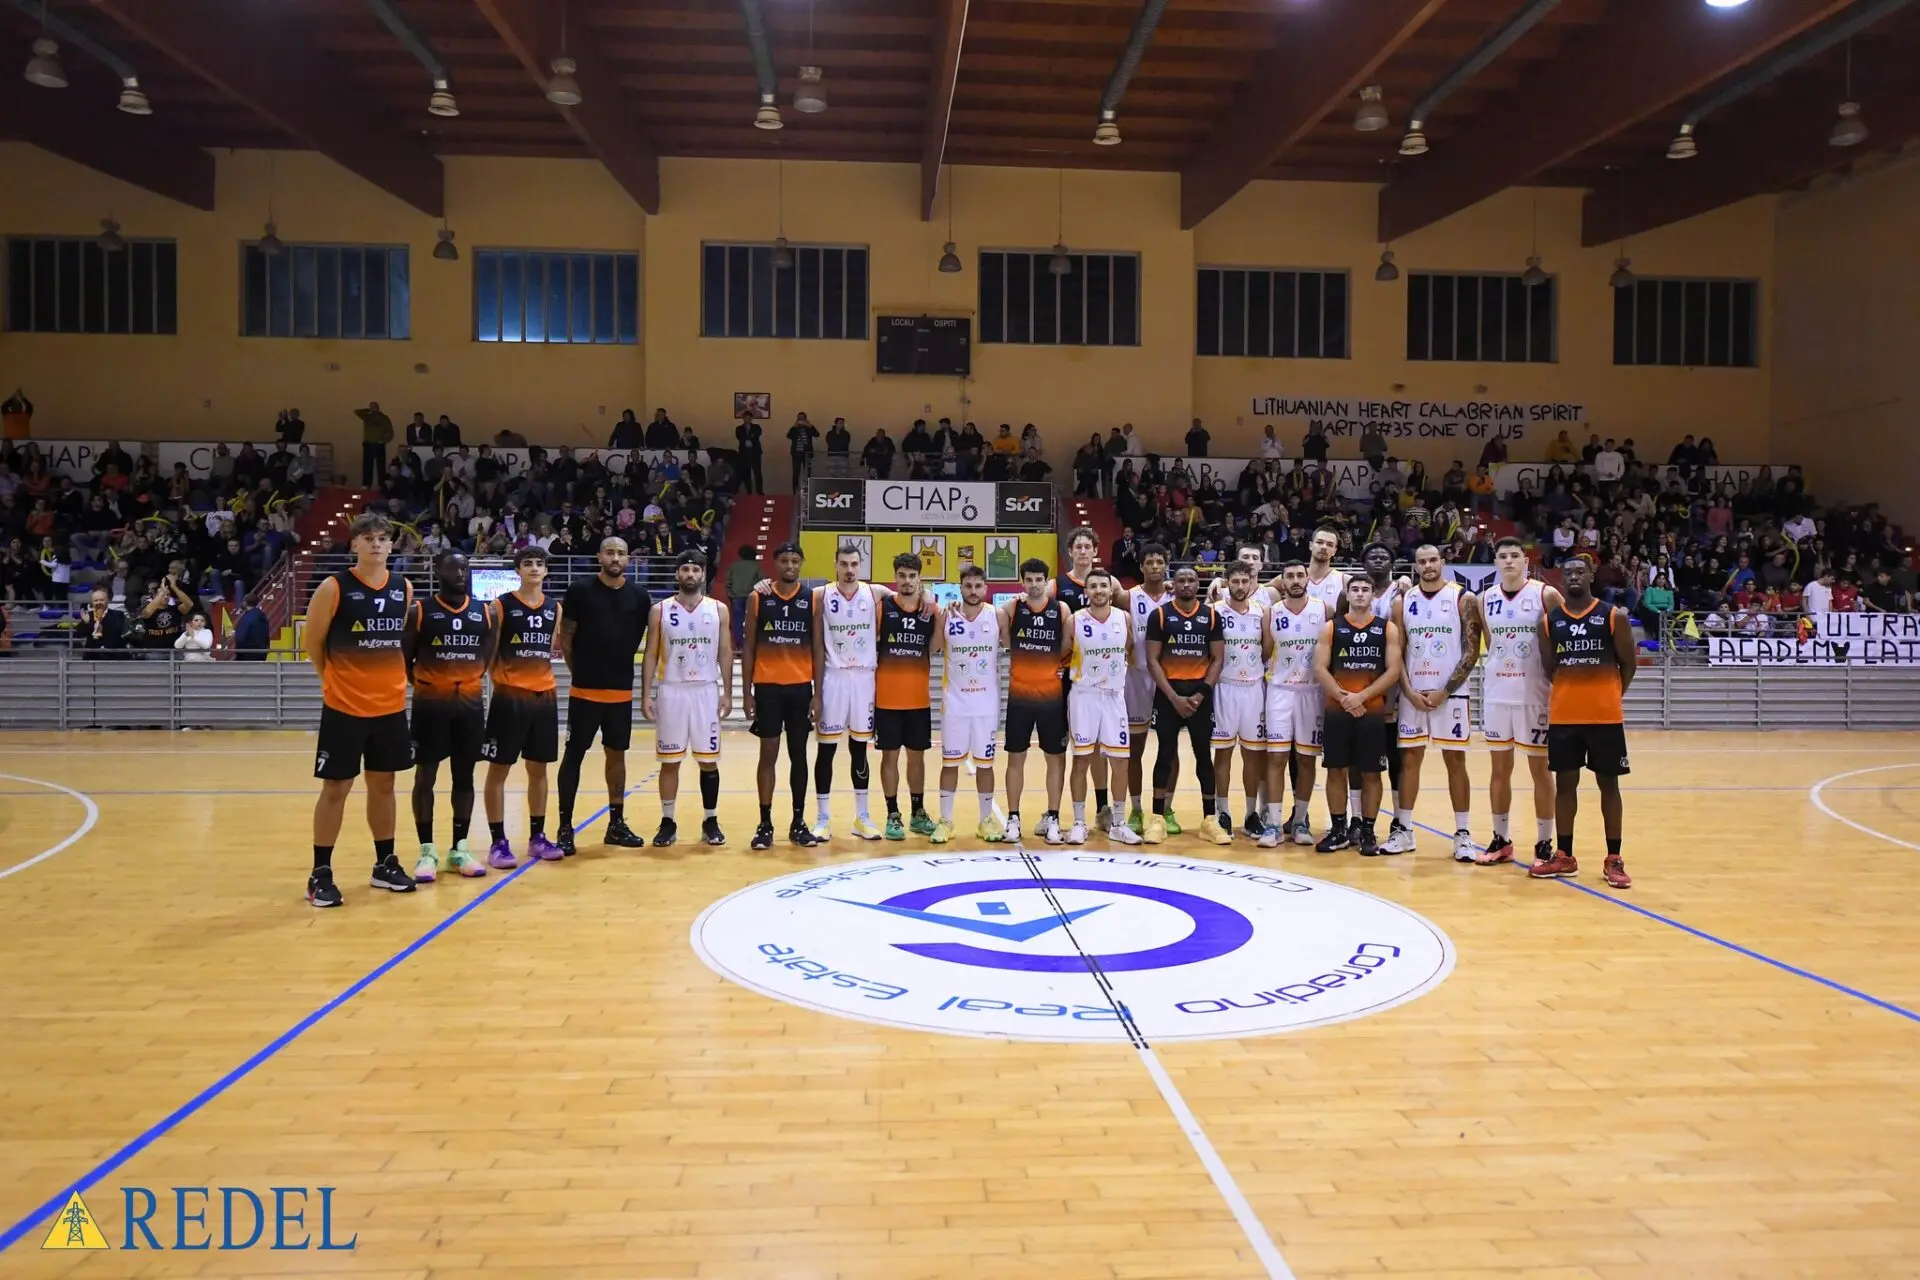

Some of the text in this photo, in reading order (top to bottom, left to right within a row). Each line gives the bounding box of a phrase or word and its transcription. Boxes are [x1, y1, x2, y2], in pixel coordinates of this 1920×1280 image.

[891, 318, 914, 326] LOCALI
[934, 320, 957, 328] OSPITI
[1359, 402, 1411, 420] HEART
[1419, 422, 1458, 438] ONE
[1466, 422, 1489, 438] OF
[1501, 424, 1524, 440] US
[374, 598, 386, 613] 7
[782, 605, 789, 617] 1
[831, 600, 839, 613] 3
[1138, 602, 1146, 615] 0
[1408, 600, 1418, 616] 4
[1487, 599, 1504, 616] 77
[366, 618, 405, 632] REDE
[452, 618, 462, 631] 0
[527, 615, 543, 628] 13
[670, 613, 679, 627] 5
[774, 620, 808, 632] REDEL
[902, 617, 916, 630] 12
[1032, 615, 1044, 627] 10
[1184, 620, 1193, 631] 3
[1275, 616, 1289, 631] 18
[1827, 612, 1920, 637] ULTRA
[828, 622, 871, 633] impronte
[949, 621, 965, 636] 25
[1083, 624, 1093, 638] 9
[1569, 623, 1588, 636] 94
[443, 634, 481, 647] REDEL
[1026, 628, 1056, 641] REDEL
[1177, 634, 1206, 645] REDEL
[1353, 632, 1368, 644] 69
[358, 638, 402, 648] MyEnerg
[952, 644, 993, 655] impronte
[1565, 638, 1605, 652] REDEL
[1084, 647, 1125, 657] impronte
[1349, 646, 1381, 657] REDEL
[1559, 656, 1600, 666] MyEnergy
[867, 716, 874, 730] 3
[1151, 714, 1157, 726] 3
[1311, 730, 1323, 744] 18
[1451, 723, 1462, 738] 4
[1531, 728, 1549, 744] 77
[709, 736, 718, 751] 5
[1119, 731, 1127, 745] 9
[316, 758, 326, 772] 7
[775, 855, 1313, 899] Corradino Real Estate
[757, 943, 1401, 1021] Corradino Real Estate
